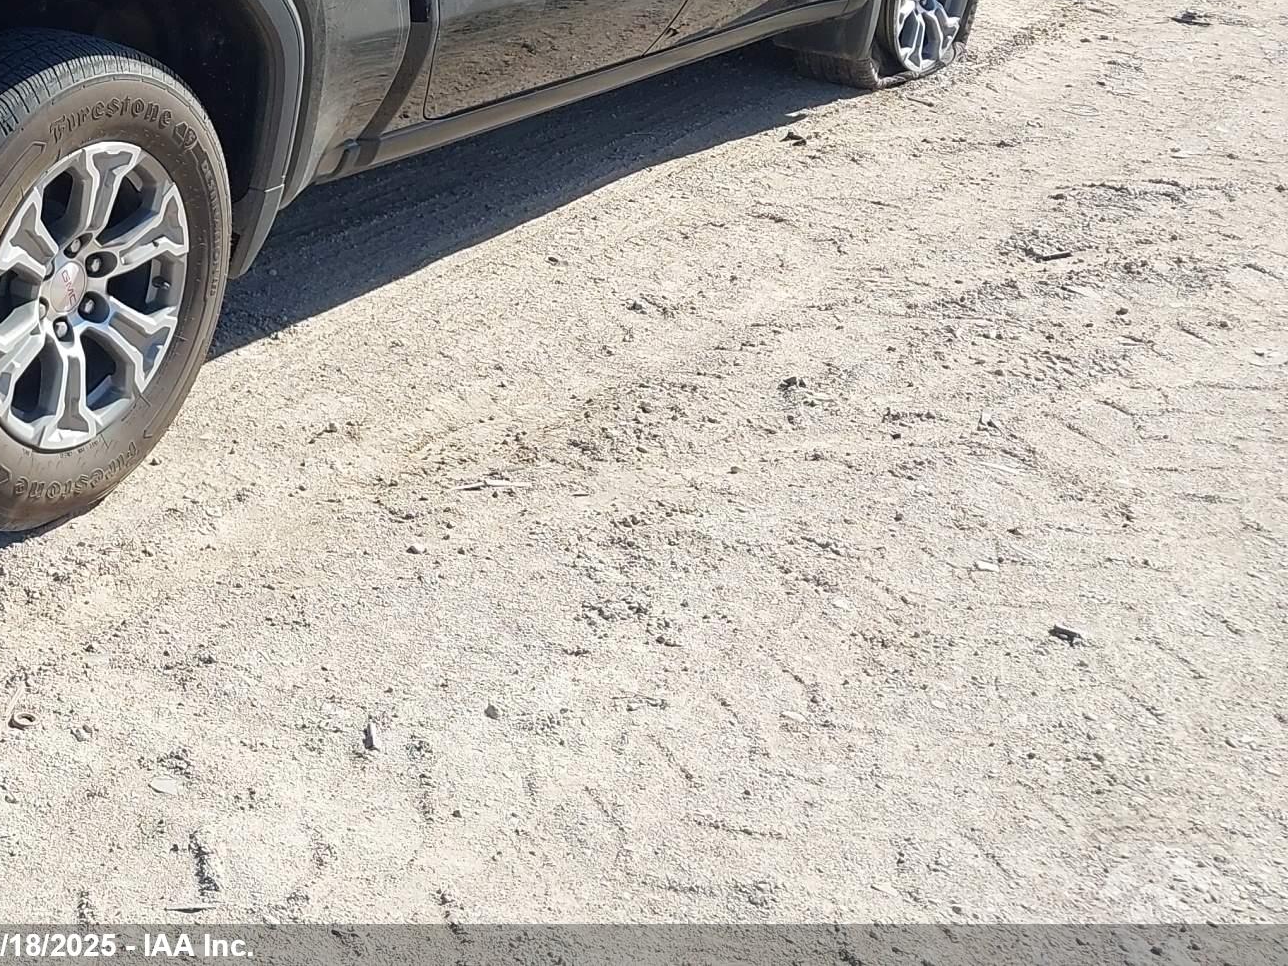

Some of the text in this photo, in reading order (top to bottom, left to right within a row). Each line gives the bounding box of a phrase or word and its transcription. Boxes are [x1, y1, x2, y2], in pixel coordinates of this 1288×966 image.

[48, 95, 173, 144] Firestone
[61, 269, 78, 307] GMC
[14, 440, 140, 499] Firestone
